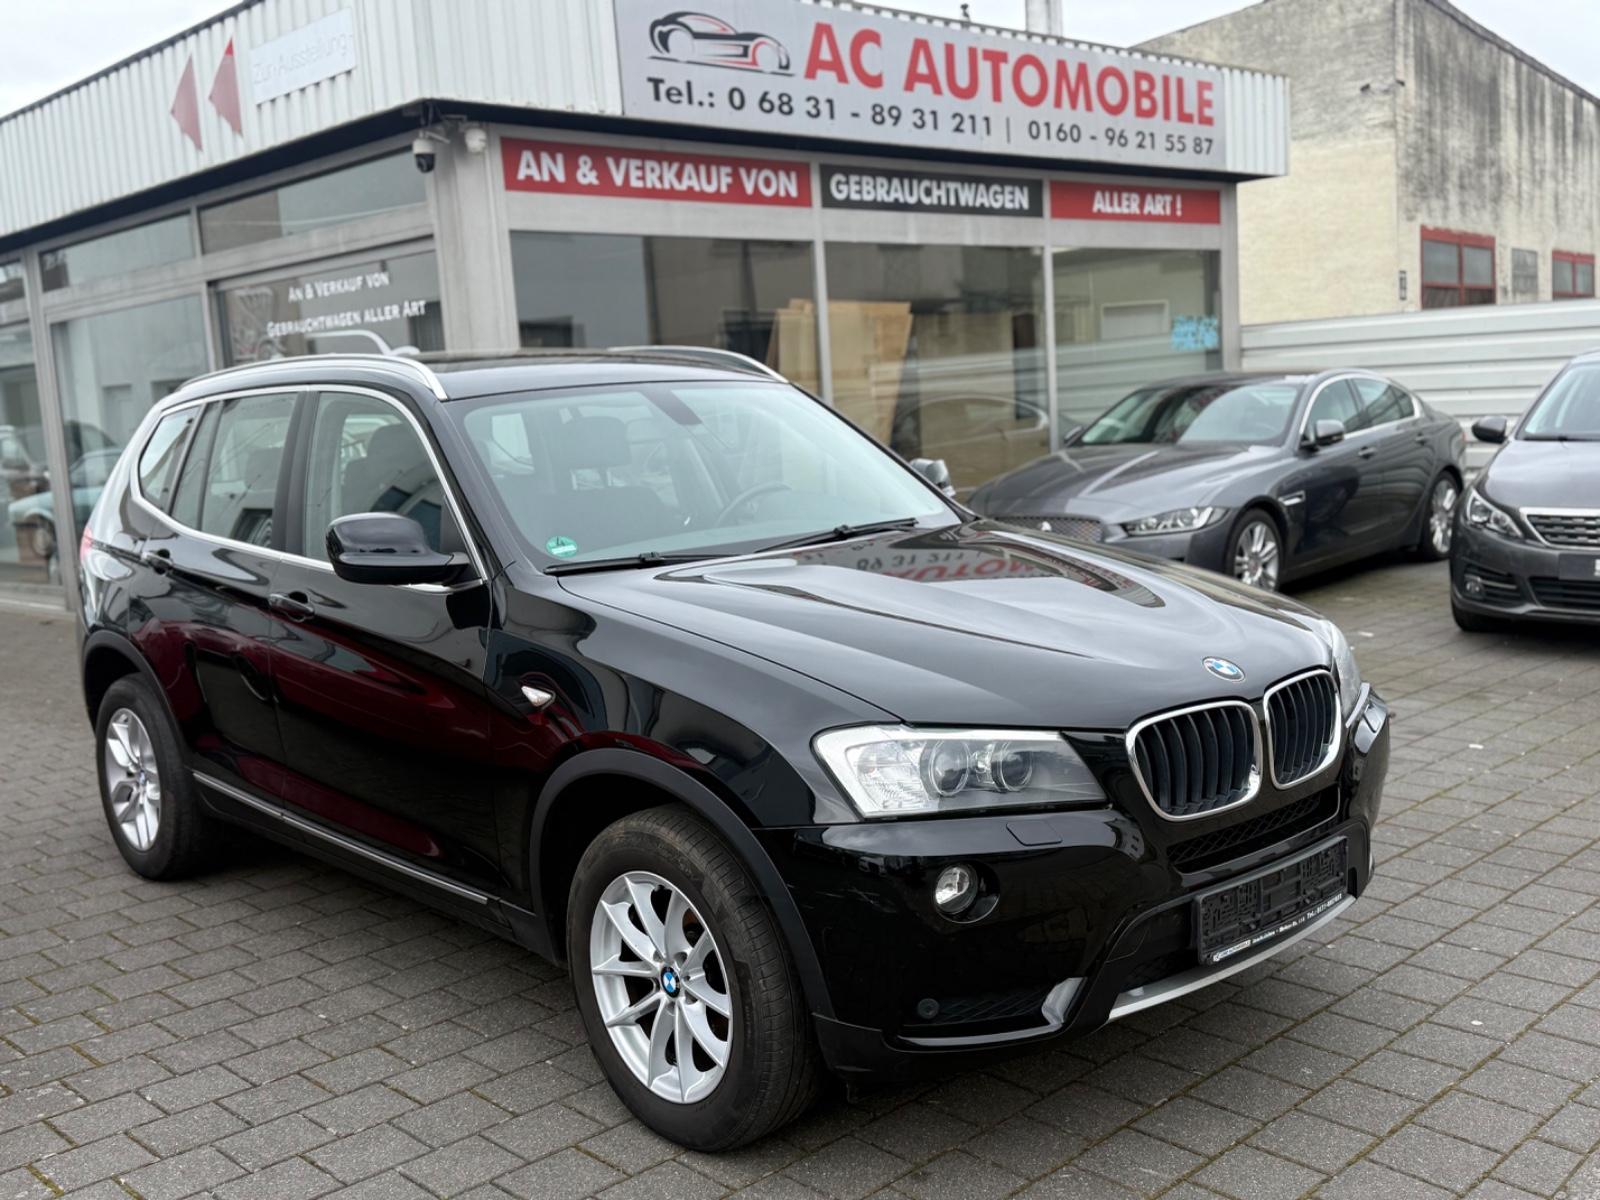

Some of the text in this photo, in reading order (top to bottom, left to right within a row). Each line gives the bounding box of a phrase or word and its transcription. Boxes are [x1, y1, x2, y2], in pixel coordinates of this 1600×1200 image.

[804, 22, 1215, 126] AC AUTOMOBILE
[647, 77, 716, 108] Tel.:
[728, 87, 746, 111] 0
[758, 91, 794, 116] 68
[805, 96, 836, 120] 31
[871, 103, 901, 127] 89
[912, 108, 939, 130] 31
[952, 112, 992, 136] 211
[1028, 120, 1082, 143] 0160
[1104, 127, 1129, 148] 96
[1135, 131, 1156, 150] 21
[1165, 133, 1187, 153] 55
[1193, 137, 1214, 155] 87
[516, 150, 798, 198] AN & VERKAUF VON
[830, 173, 1029, 210] GEBRAUCHTWAGEN
[1092, 190, 1141, 215] ALLER
[1143, 193, 1173, 216] ART
